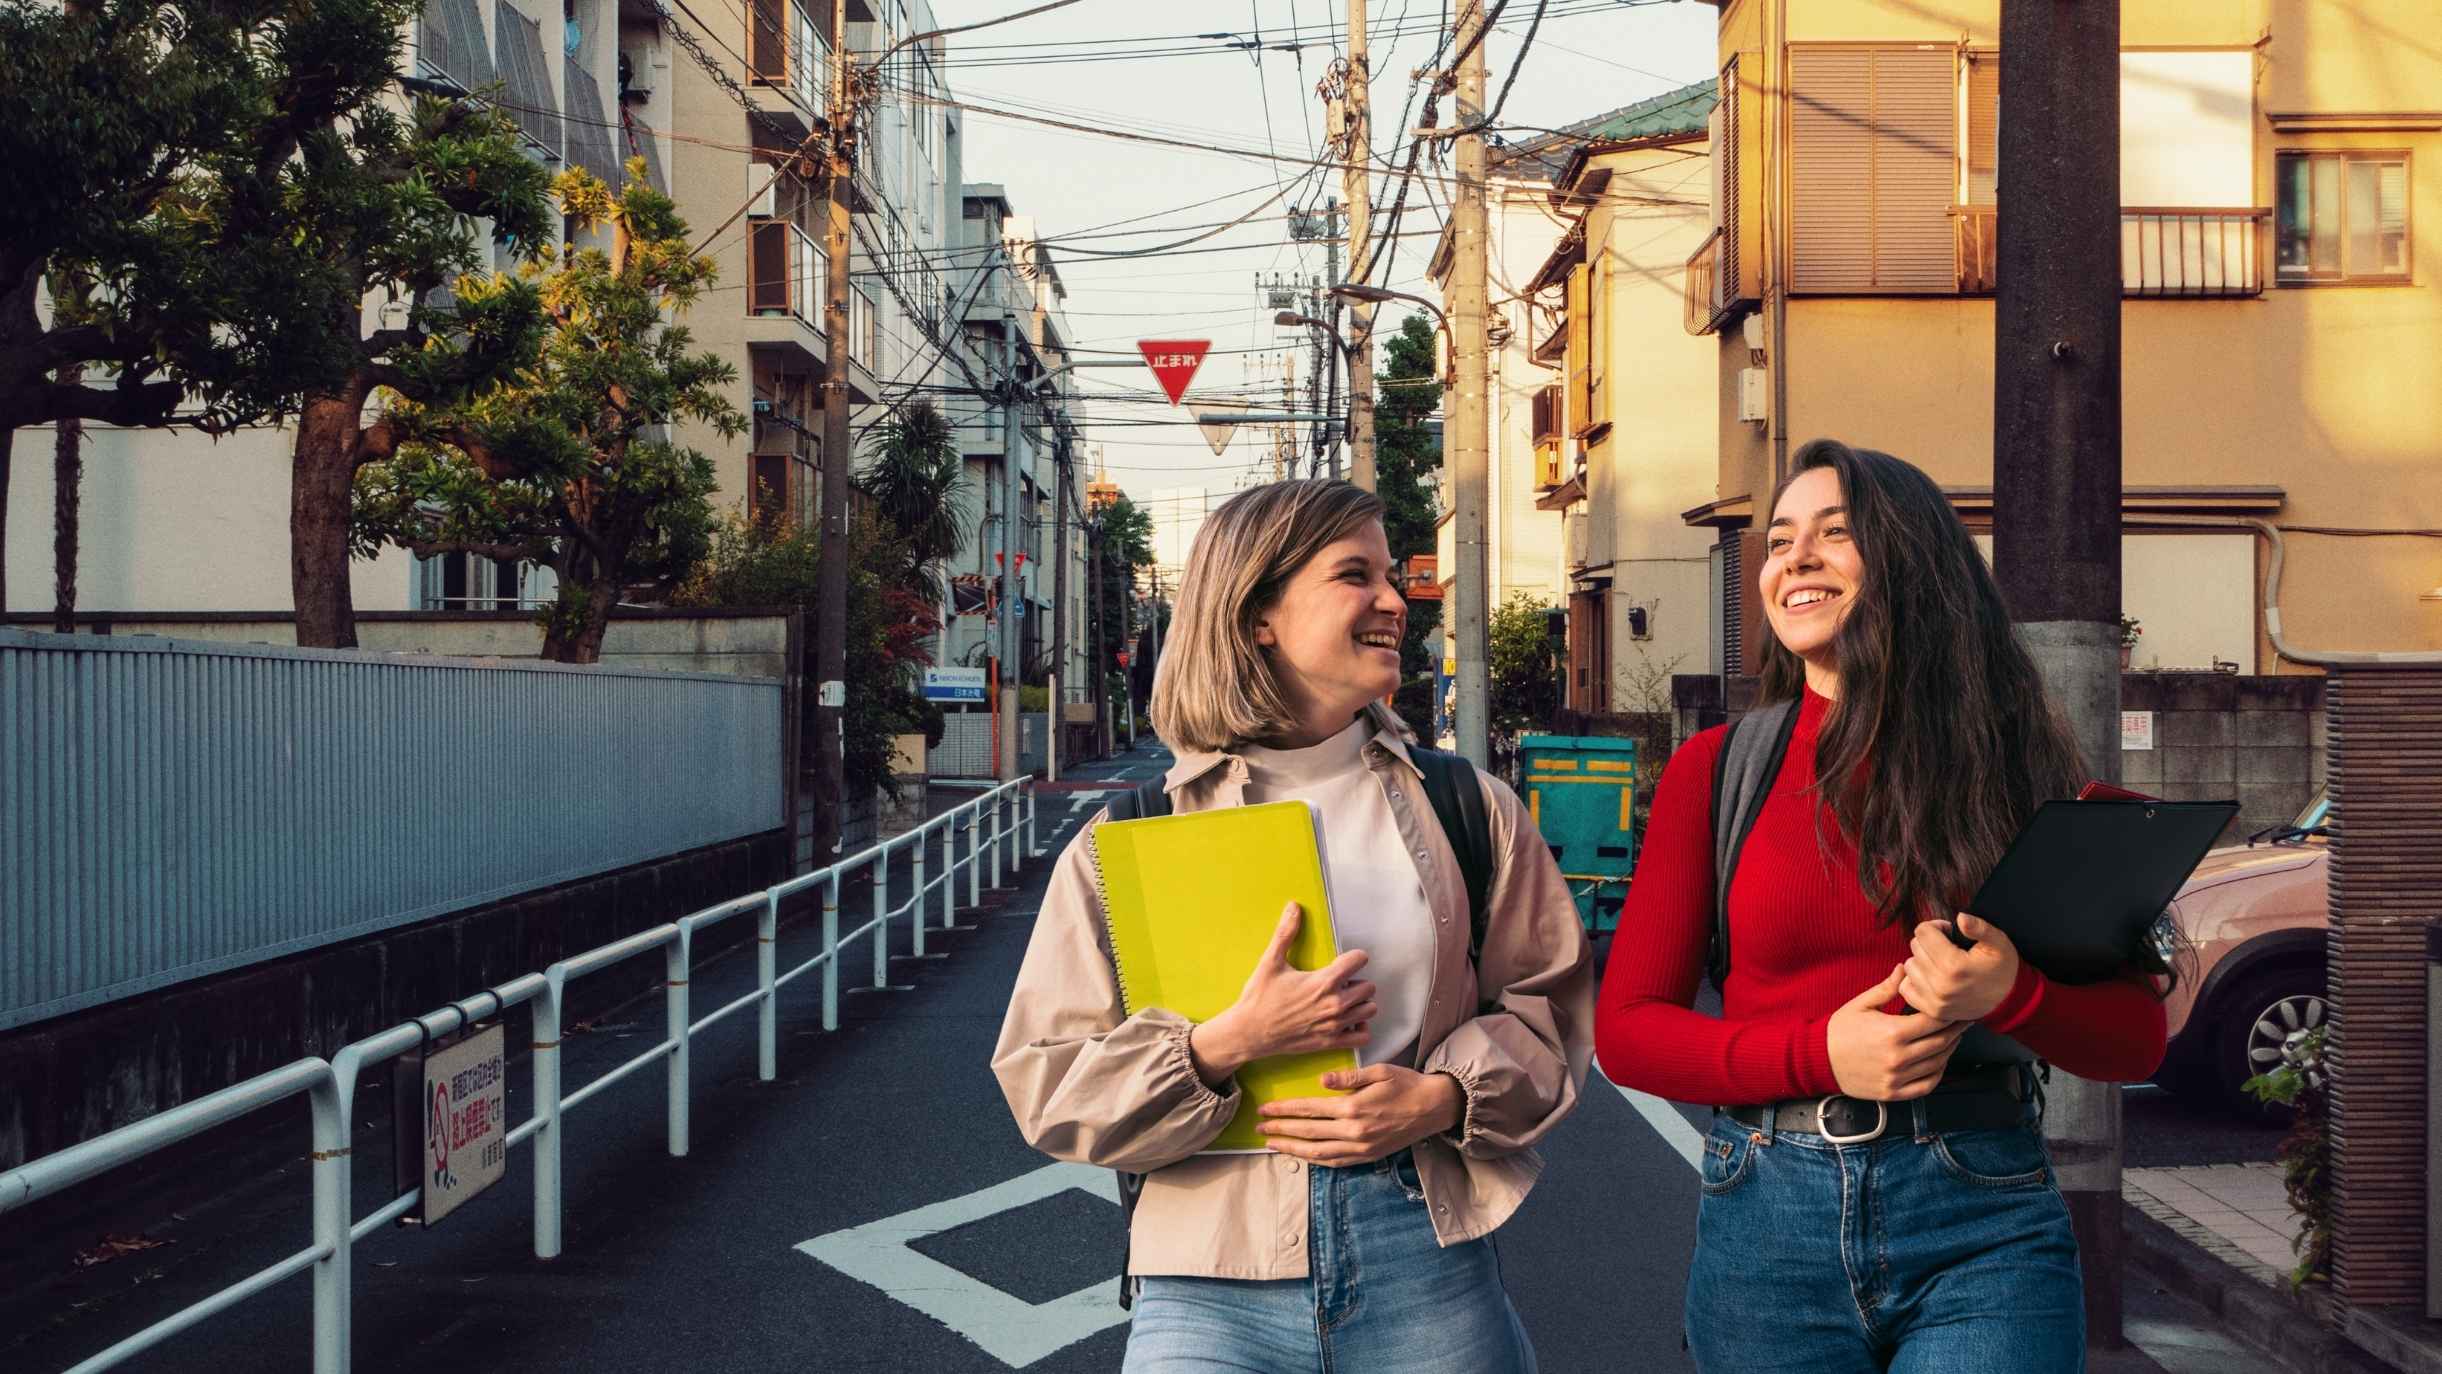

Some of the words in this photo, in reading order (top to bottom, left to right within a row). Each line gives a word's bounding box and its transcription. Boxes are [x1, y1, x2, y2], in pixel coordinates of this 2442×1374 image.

[1153, 352, 1198, 368] 止まれ
[452, 1095, 502, 1151] 路上喫煙禁止です
